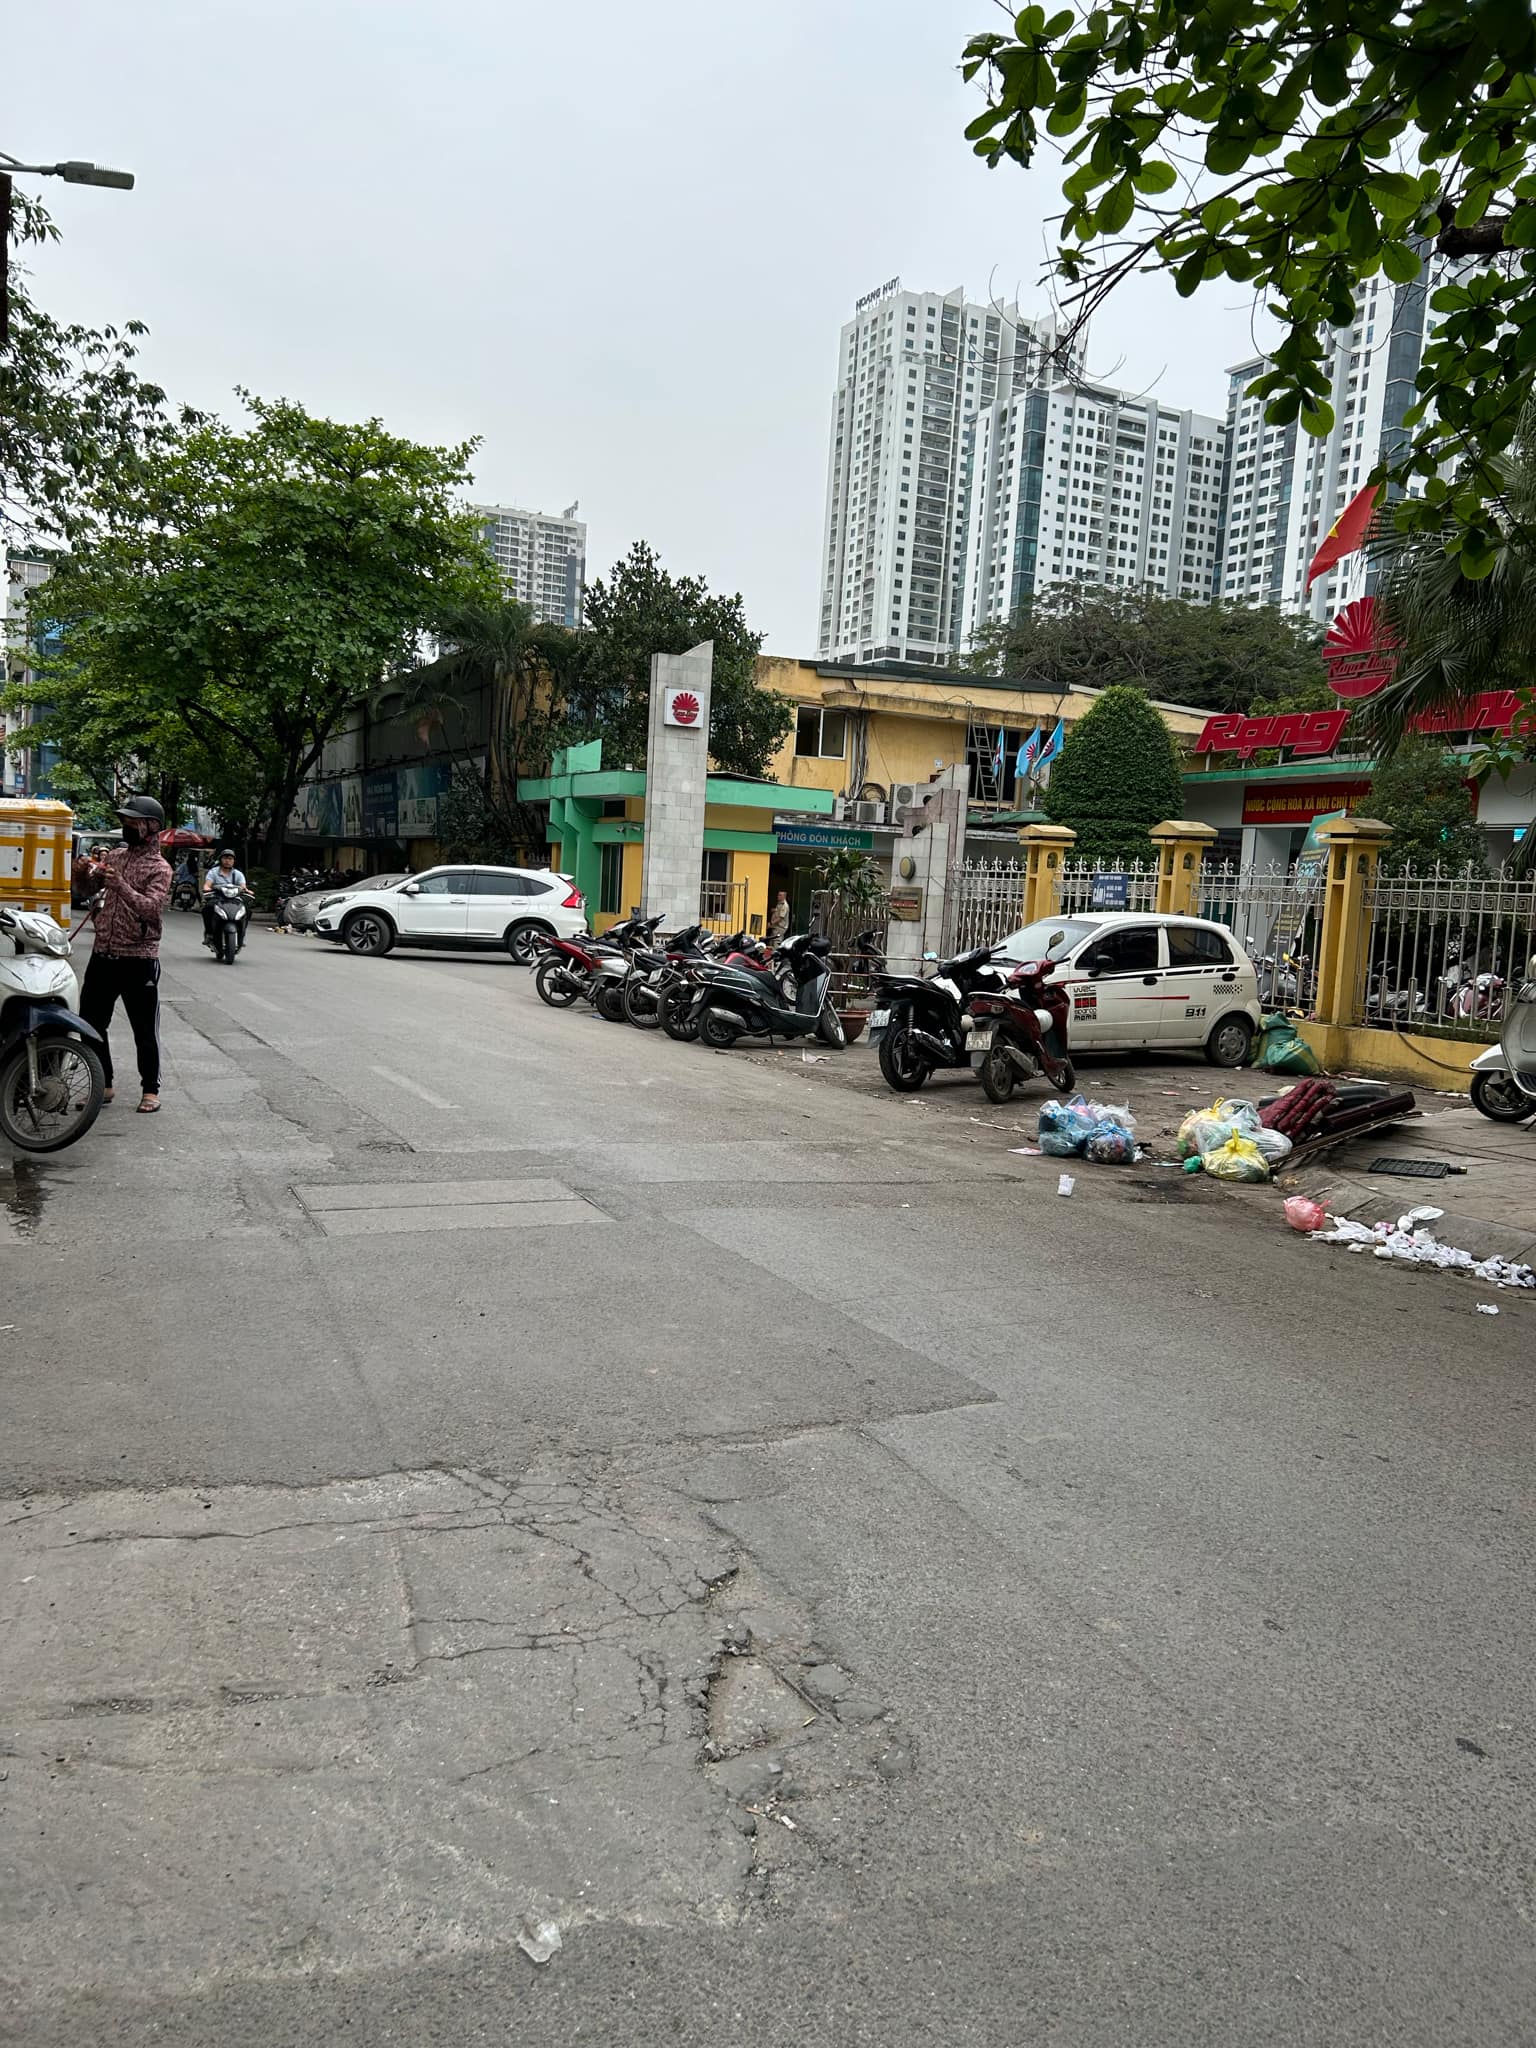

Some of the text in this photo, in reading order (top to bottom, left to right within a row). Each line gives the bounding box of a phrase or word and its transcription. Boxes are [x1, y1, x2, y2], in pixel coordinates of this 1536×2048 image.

[1195, 710, 1350, 759] Rạng
[775, 830, 860, 846] PHÒNG ĐÓN KHÁCH
[1185, 1007, 1207, 1017] 911
